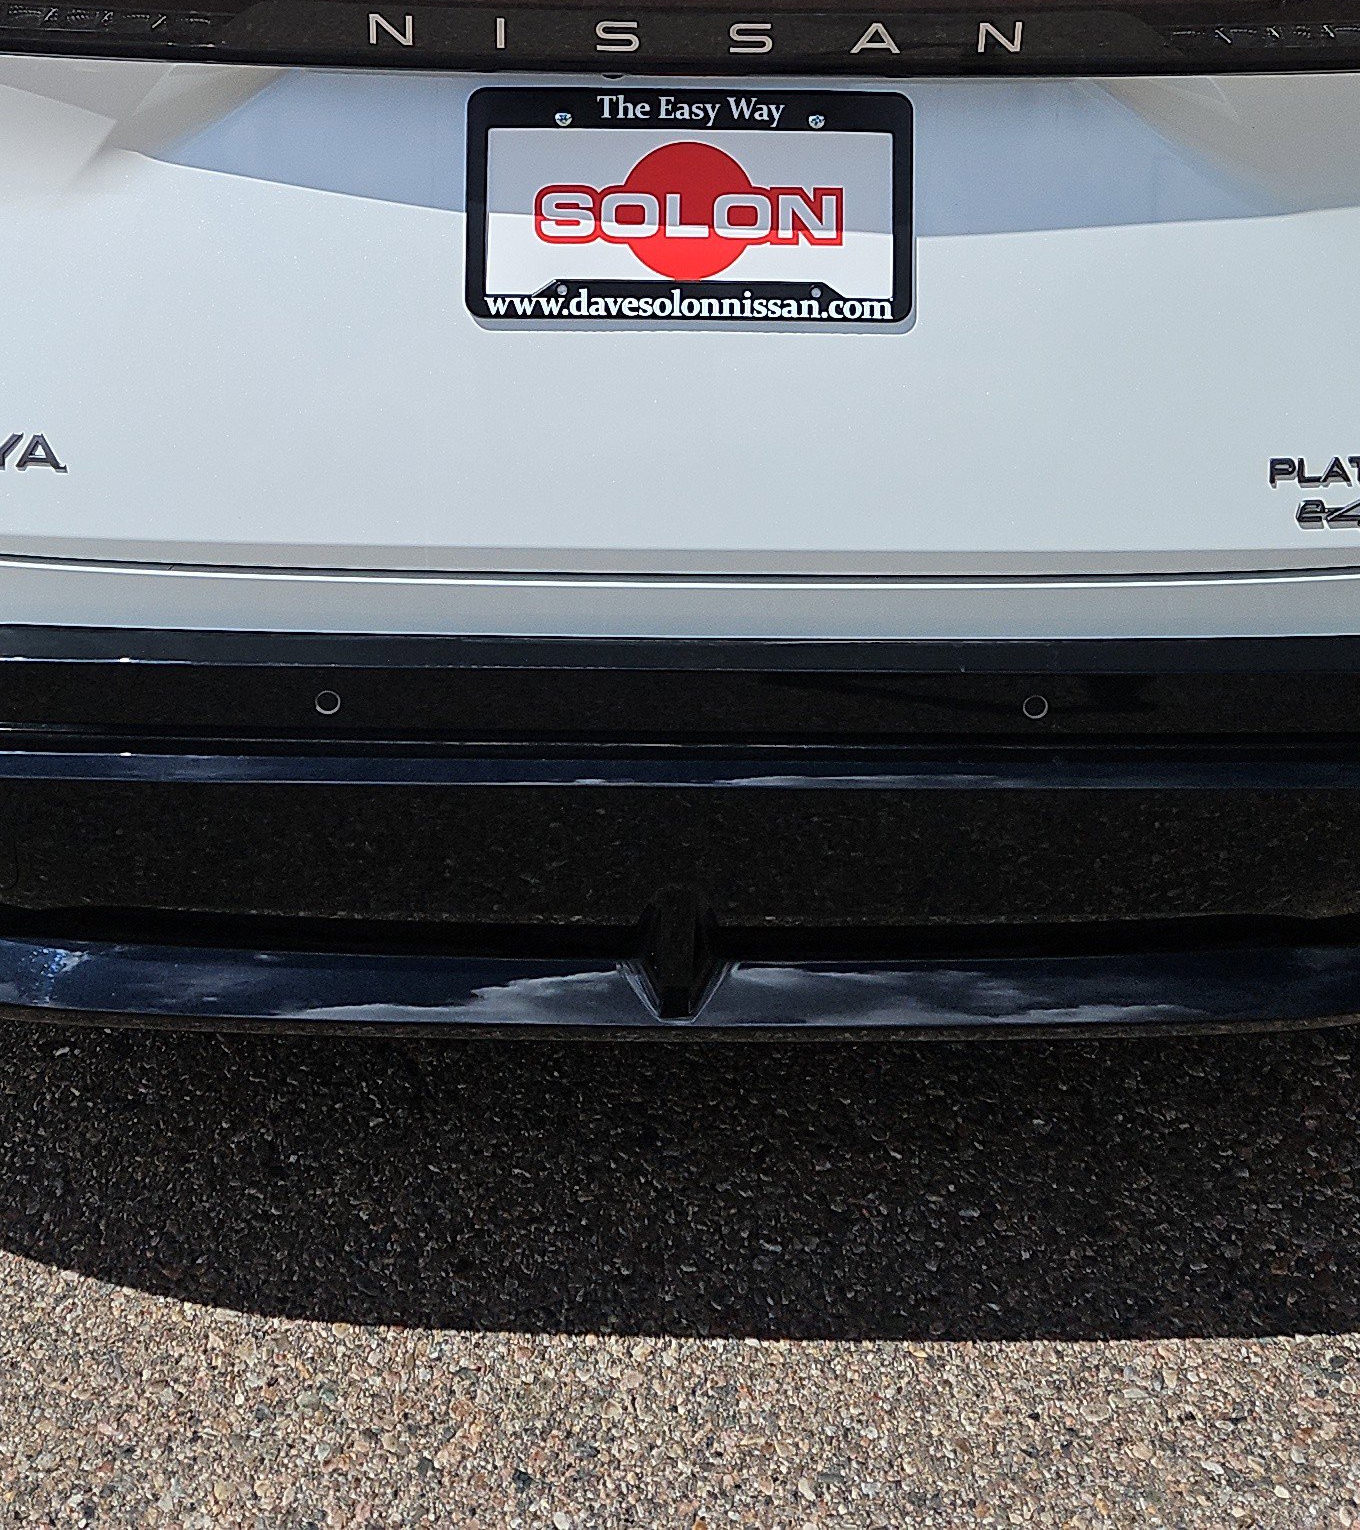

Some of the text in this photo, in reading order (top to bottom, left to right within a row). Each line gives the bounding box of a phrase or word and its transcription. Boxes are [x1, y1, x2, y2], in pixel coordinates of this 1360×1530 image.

[368, 13, 1023, 54] NISSAN
[597, 94, 785, 127] The Easy Way
[536, 185, 844, 246] SOLON
[484, 289, 894, 320] www.davesolonnissan.com
